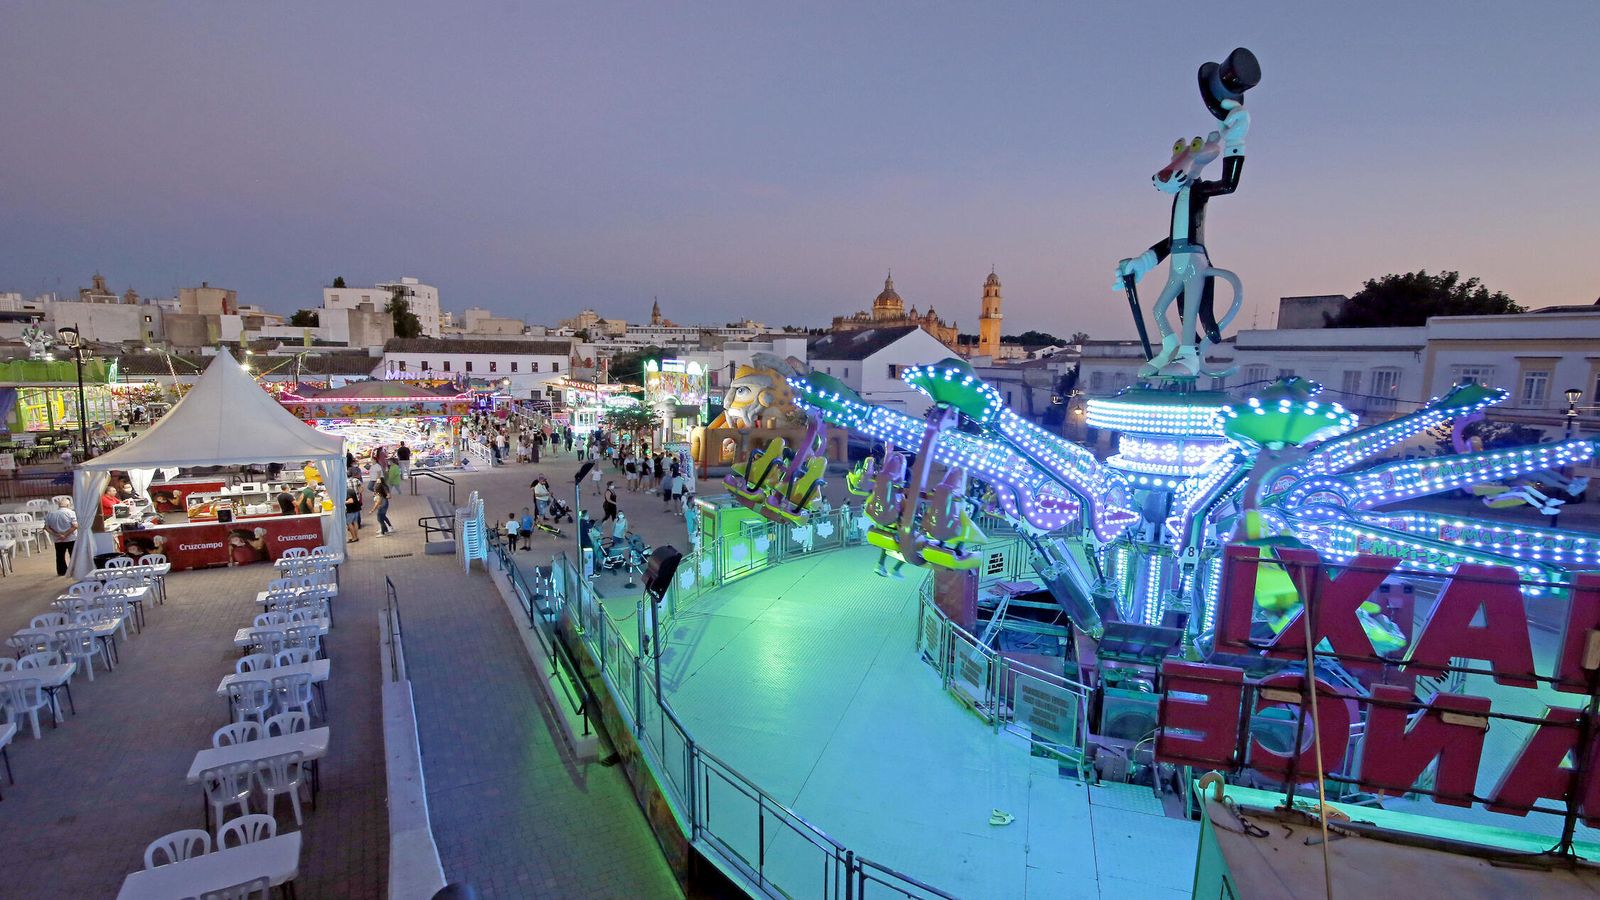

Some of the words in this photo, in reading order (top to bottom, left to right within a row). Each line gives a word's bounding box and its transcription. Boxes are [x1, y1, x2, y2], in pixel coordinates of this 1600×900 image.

[277, 532, 318, 542] Cruzcampo
[179, 541, 223, 551] Cruzcampo
[1187, 546, 1195, 558] 8
